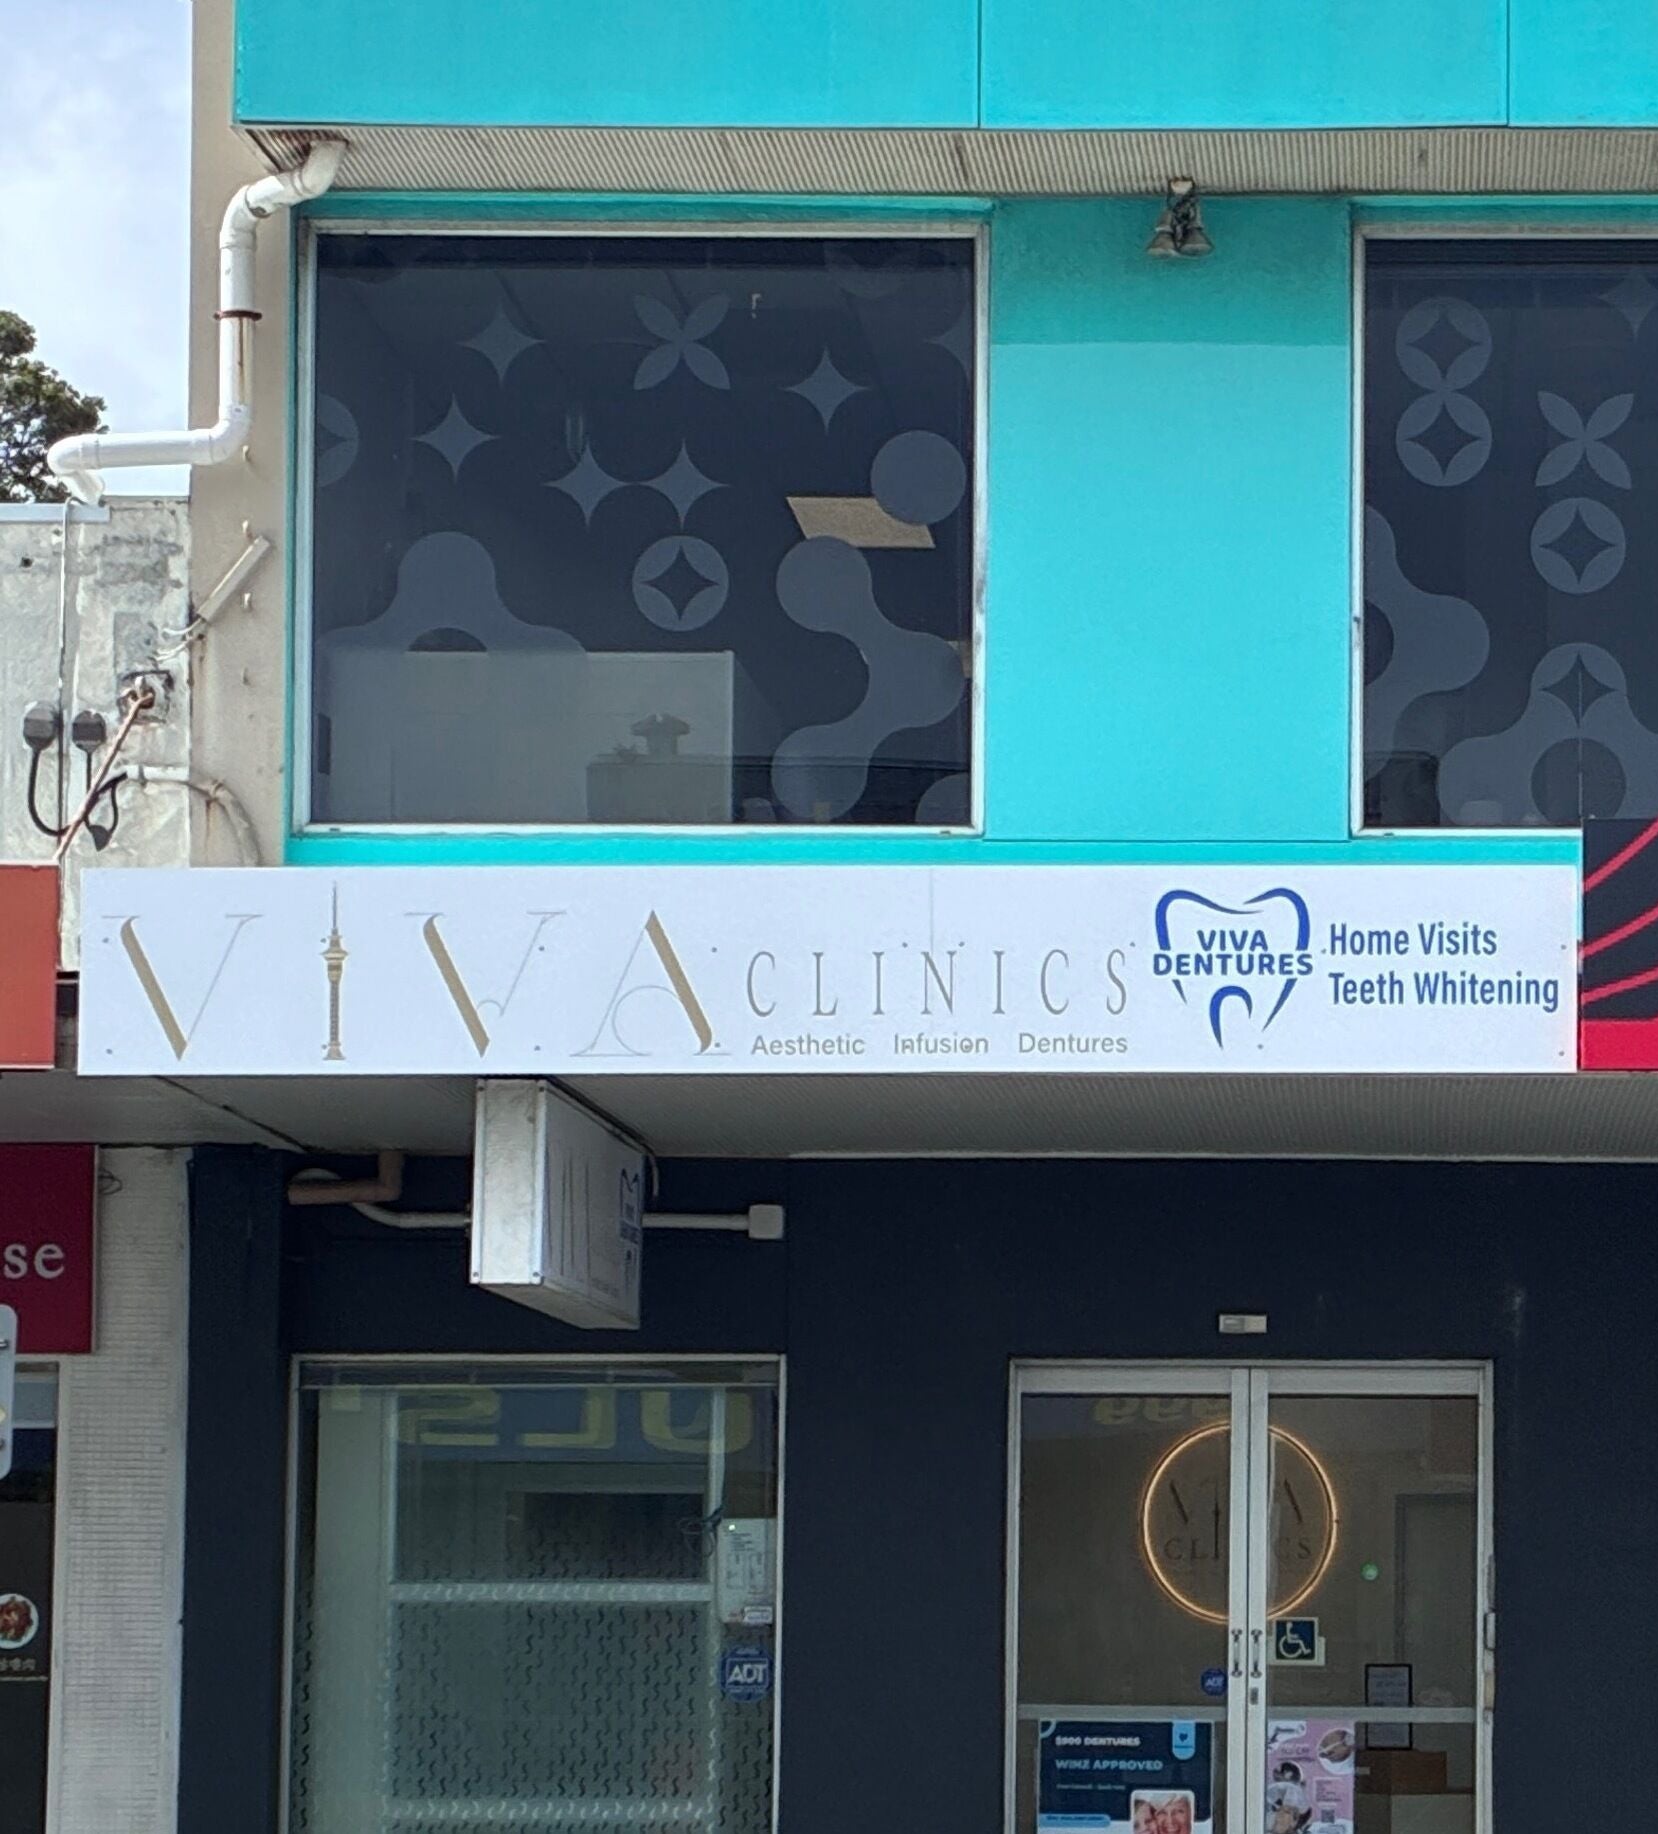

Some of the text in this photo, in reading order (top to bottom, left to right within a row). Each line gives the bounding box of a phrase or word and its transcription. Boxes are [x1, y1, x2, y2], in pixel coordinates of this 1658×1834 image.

[1196, 929, 1269, 952] VIVA
[1330, 920, 1498, 956] Home Visits
[1152, 952, 1314, 977] DENTURES
[746, 949, 1128, 1018] CLINICS
[1328, 970, 1560, 1014] Teeth Whitening
[750, 1031, 1129, 1056] Aesthetic Infusion Dentures
[728, 1663, 769, 1685] ADT
[1084, 1736, 1141, 1748] DENTURES
[1093, 1758, 1163, 1771] APPROVED
